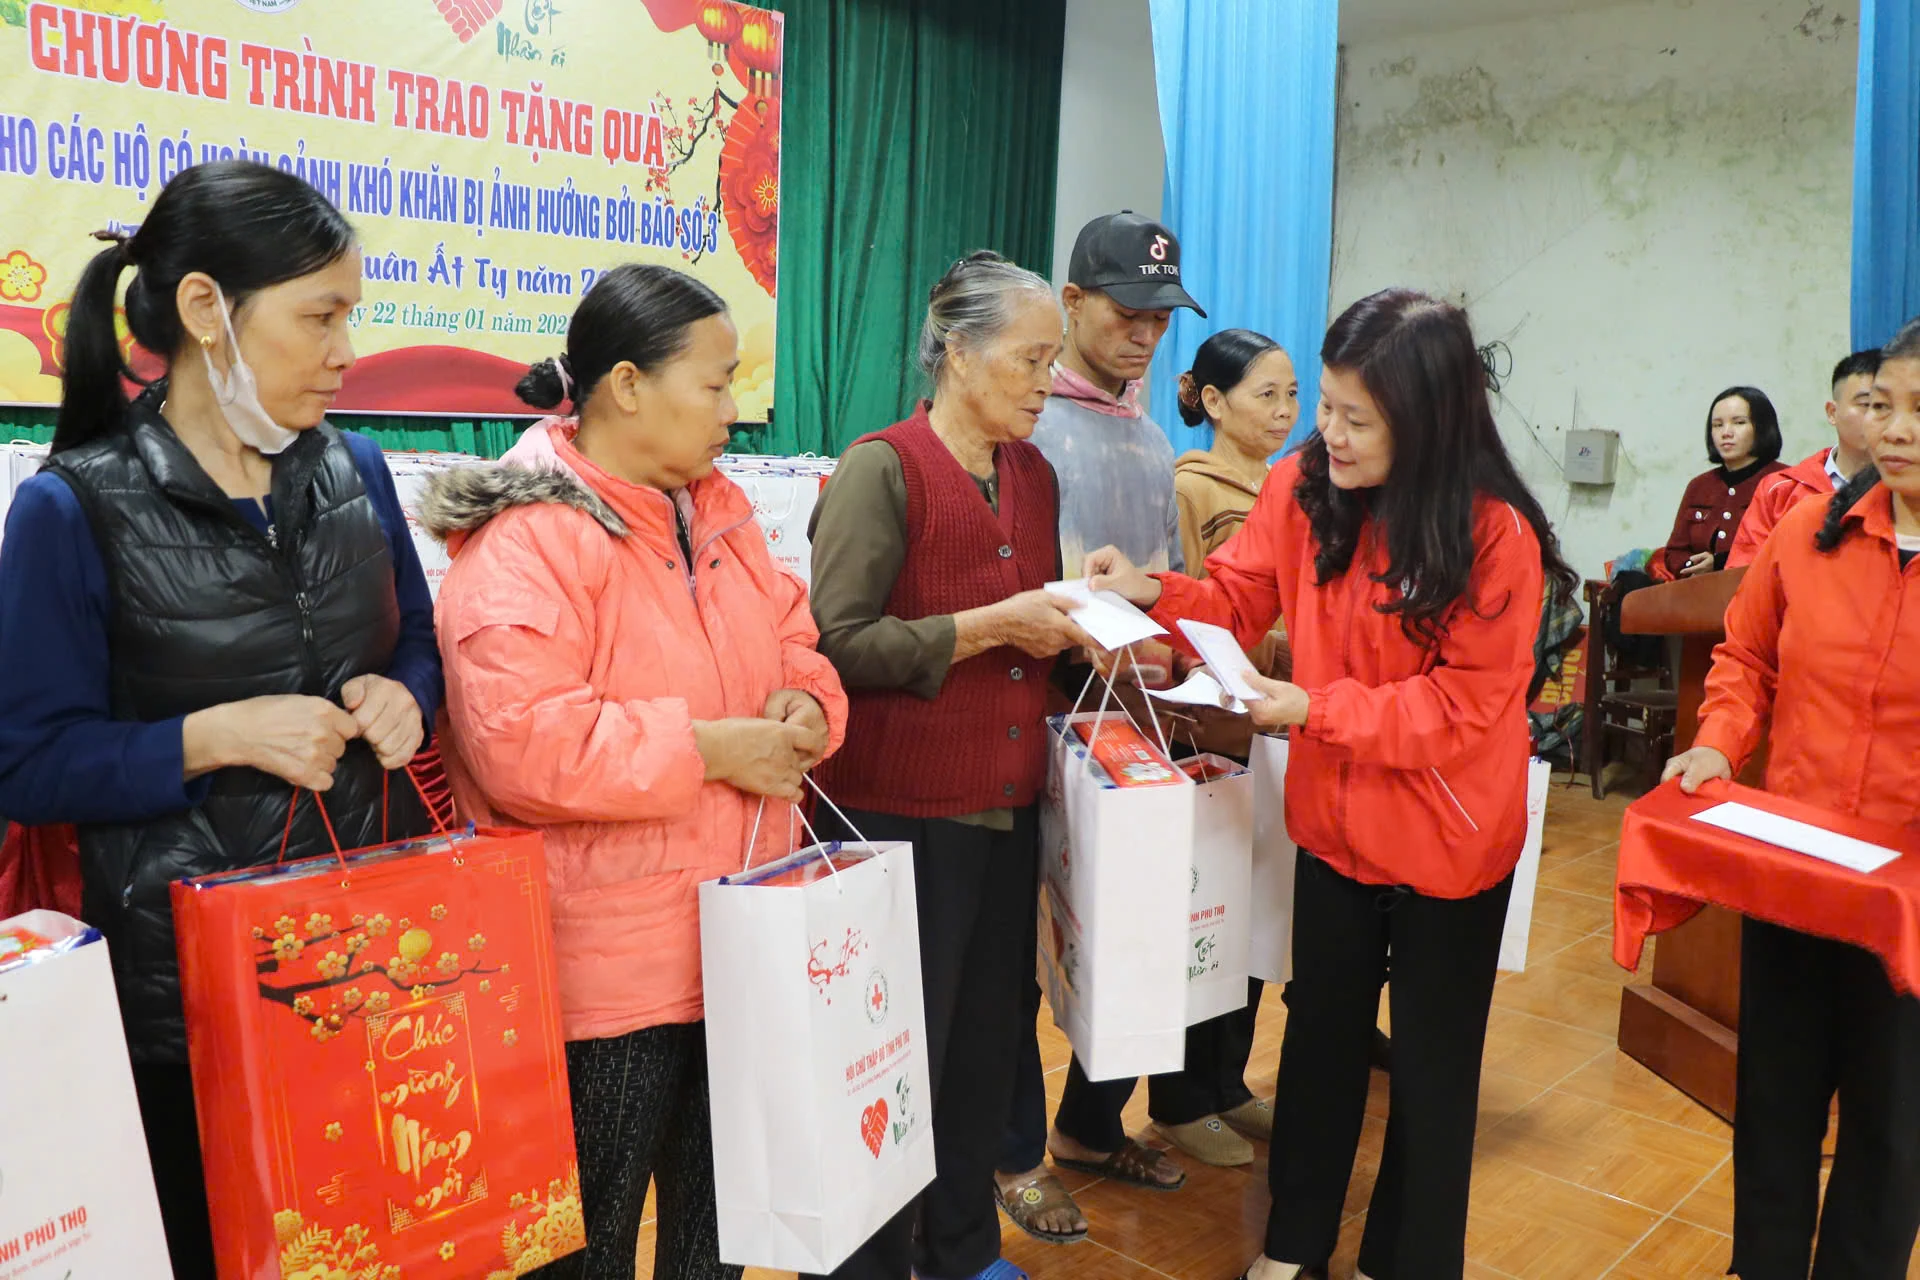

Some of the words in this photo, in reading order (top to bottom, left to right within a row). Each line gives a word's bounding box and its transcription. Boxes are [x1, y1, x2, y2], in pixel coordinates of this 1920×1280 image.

[29, 3, 228, 99] CHƯƠNG
[241, 37, 375, 122] TRÌNH
[387, 69, 488, 139] TRAO
[501, 82, 593, 163] TẶNG
[603, 101, 664, 167] QUÀ
[48, 114, 104, 183] CÁC
[114, 123, 149, 200] HỘ
[348, 158, 392, 216] KHÓ
[400, 164, 457, 223] KHĂN
[464, 179, 483, 236] BỊ
[490, 167, 528, 232] ẢNH
[536, 177, 600, 239] HƯỞNG
[606, 185, 635, 244] BỞI
[641, 199, 675, 248] BÃO
[680, 194, 706, 252] SỐ
[707, 211, 717, 253] 3
[361, 250, 417, 283] uân
[427, 242, 464, 289] Ất
[474, 257, 508, 298] Tỵ
[517, 265, 572, 296] năm
[1138, 264, 1161, 275] TIK
[1161, 264, 1179, 276] TOK
[372, 301, 396, 325] 22
[402, 303, 461, 333] tháng
[465, 308, 485, 330] 01
[491, 311, 532, 334] năm
[536, 313, 571, 335] 202
[382, 1013, 458, 1061] Chúc
[24, 1216, 56, 1252] PHÚ
[59, 1205, 87, 1233] THỌ
